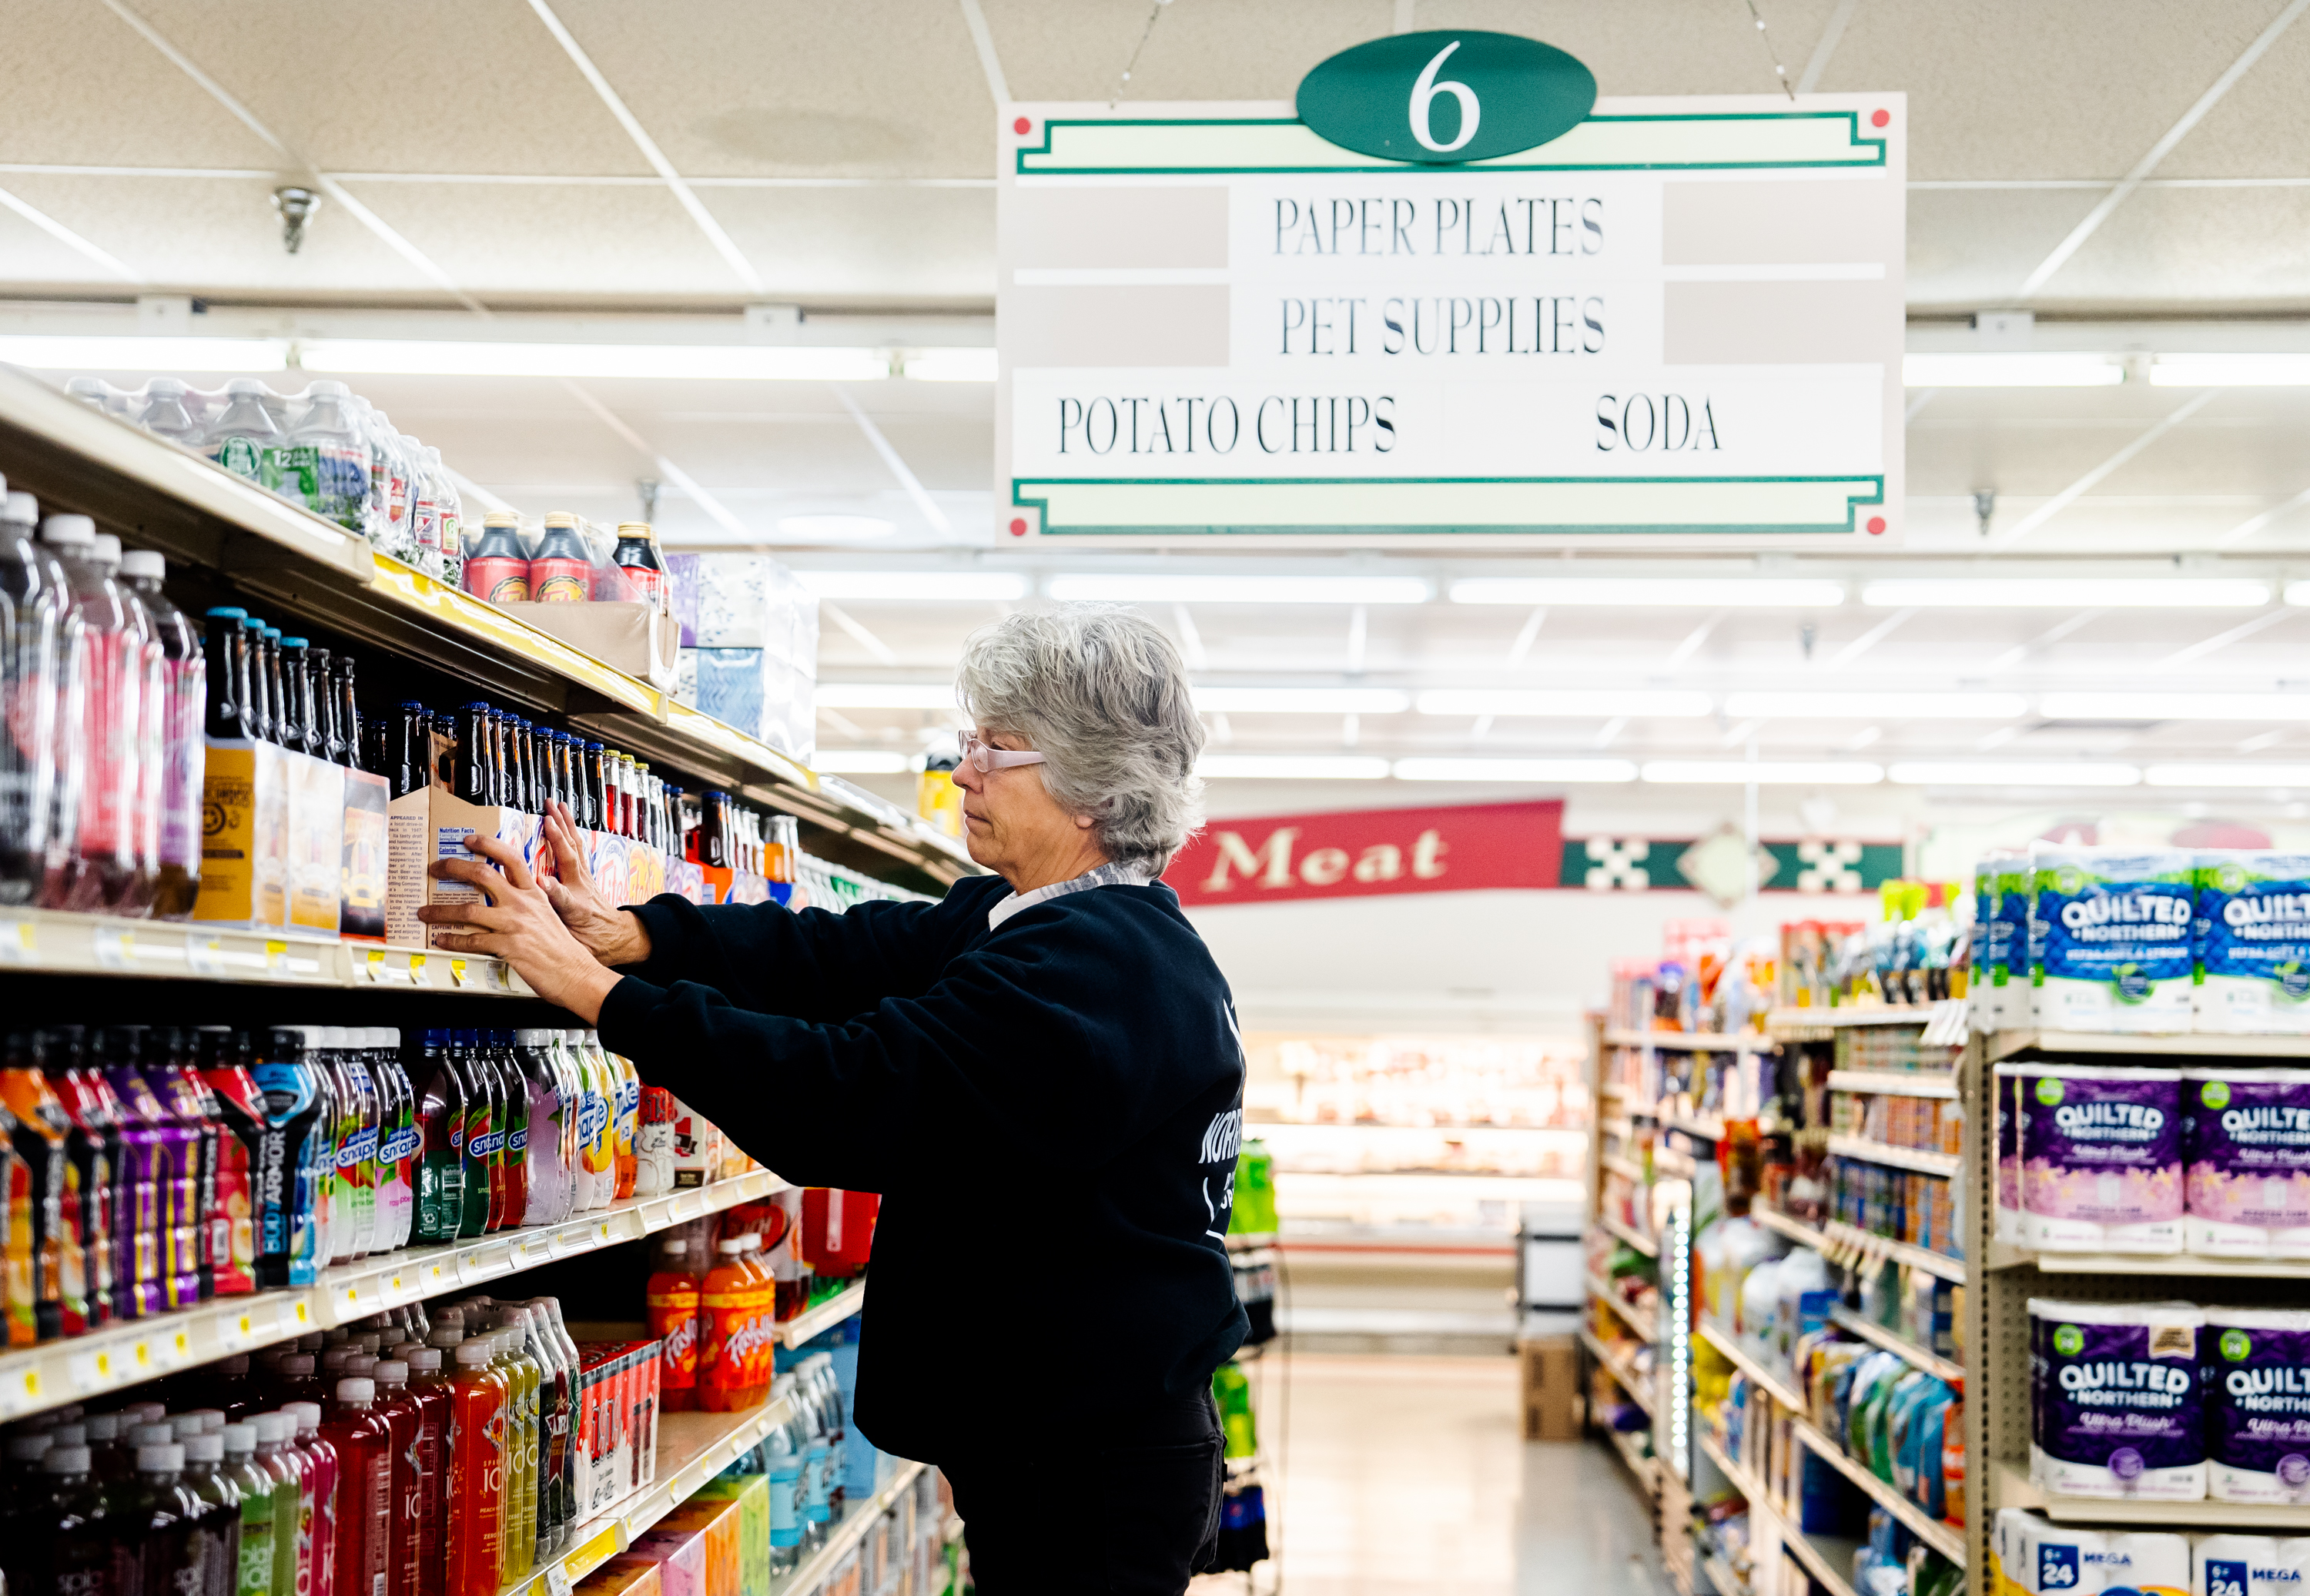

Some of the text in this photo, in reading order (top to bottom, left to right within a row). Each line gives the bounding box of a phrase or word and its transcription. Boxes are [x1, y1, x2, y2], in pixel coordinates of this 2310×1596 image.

[1409, 41, 1481, 153] 6
[1273, 196, 1605, 257] PAPER PLATES
[1279, 295, 1607, 356] PET SUPPLIES
[1056, 393, 1398, 455] POTATO CHIPS
[1595, 392, 1722, 452] SODA
[1200, 826, 1448, 892] Meat
[2061, 895, 2191, 929] QUILTED
[2082, 924, 2179, 942] NORTHERN
[2055, 1102, 2164, 1132] QUILTED
[2221, 1106, 2310, 1133] QUILTE
[2071, 1127, 2151, 1142] NORTHERN
[2060, 1362, 2190, 1395] QUILTED
[2080, 1390, 2174, 1408] NORTHERN
[2080, 1411, 2176, 1430] Ultra Plush
[2248, 1417, 2291, 1434] Ultra
[2084, 1551, 2132, 1566] MEGA
[2043, 1563, 2074, 1585] 24
[2252, 1568, 2302, 1583] MEGA
[2211, 1580, 2245, 1596] 24
